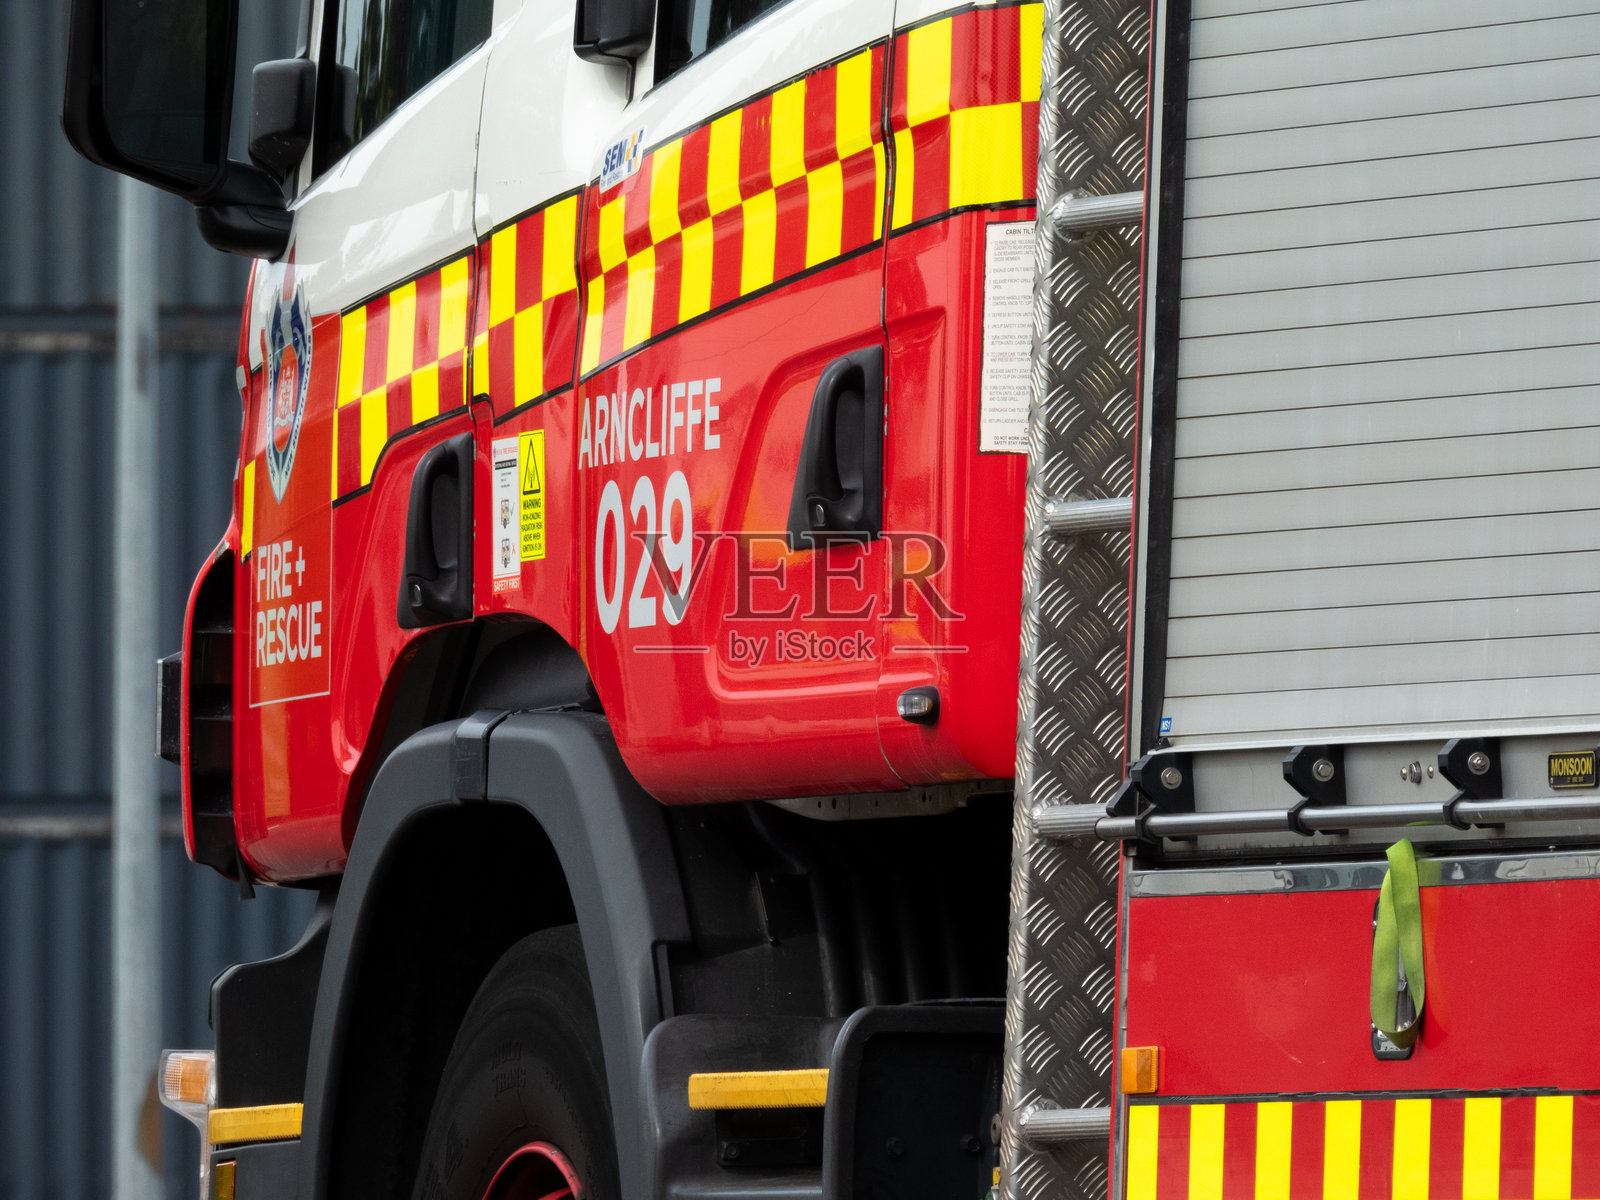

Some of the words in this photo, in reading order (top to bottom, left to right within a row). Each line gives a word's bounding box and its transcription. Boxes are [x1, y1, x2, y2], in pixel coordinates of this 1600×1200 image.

[603, 139, 628, 176] SEM
[578, 377, 721, 470] ARNCLIFFE
[595, 470, 693, 634] 029
[494, 579, 508, 592] SAFETY
[509, 577, 520, 589] FIRST
[256, 601, 322, 668] RESCUE
[1551, 757, 1593, 777] MONSOON
